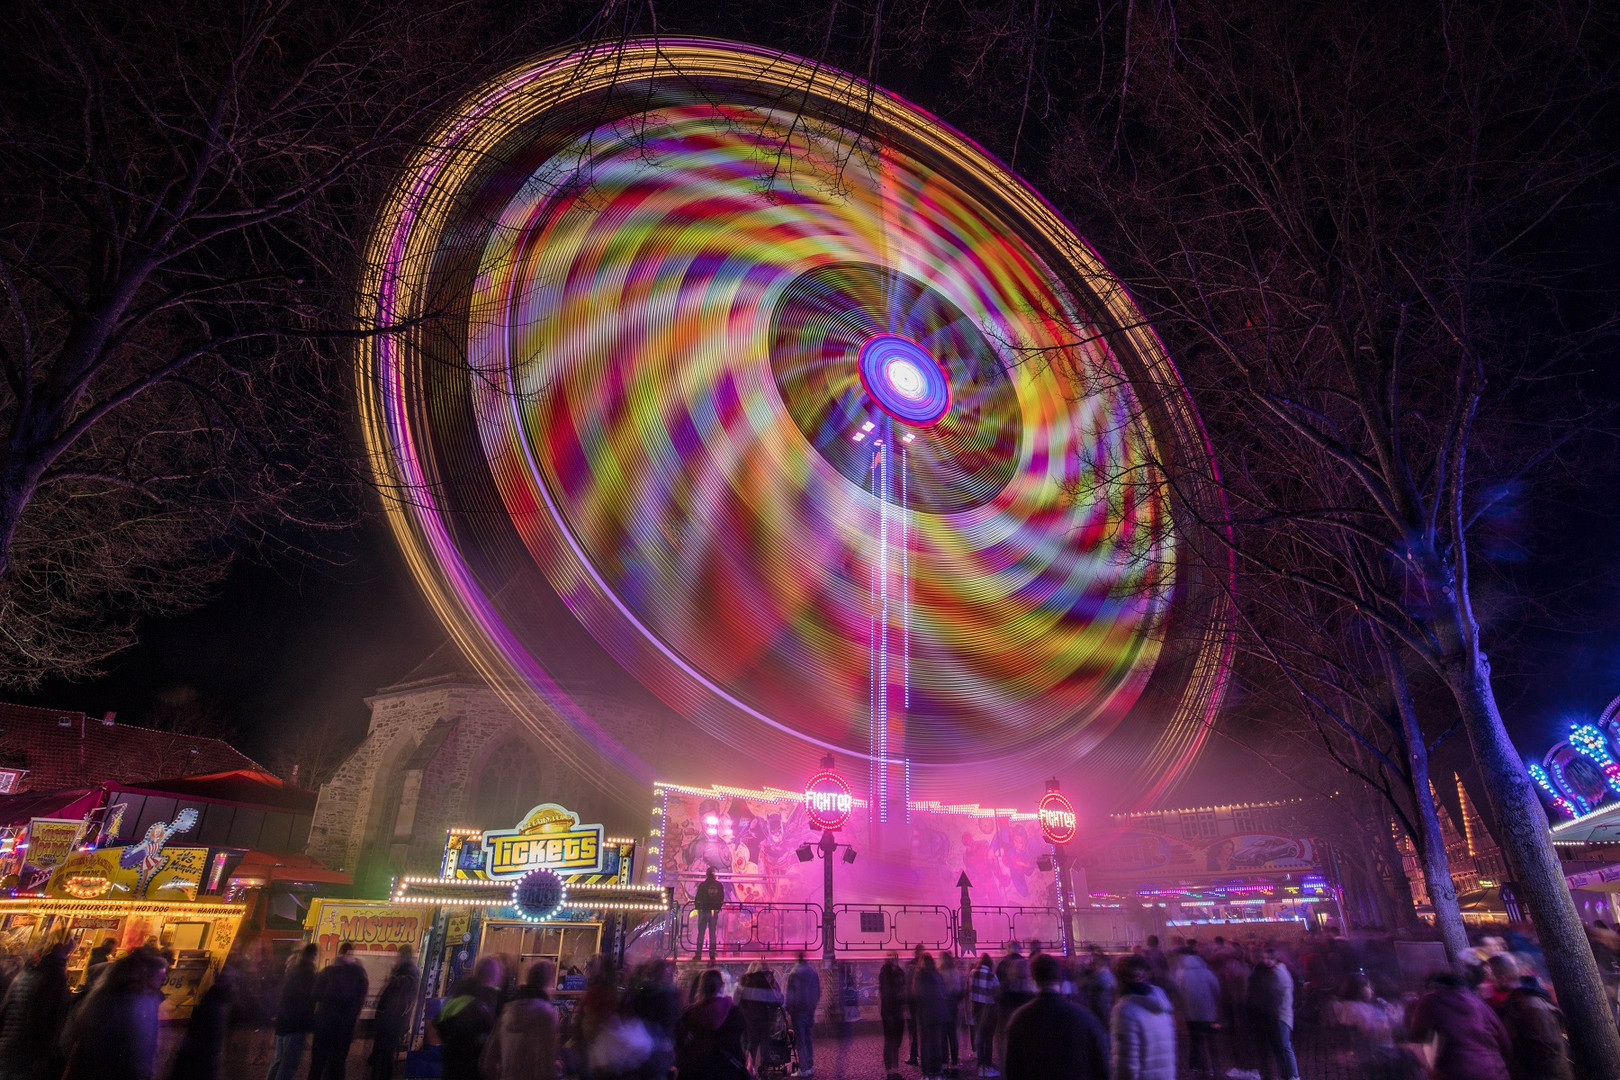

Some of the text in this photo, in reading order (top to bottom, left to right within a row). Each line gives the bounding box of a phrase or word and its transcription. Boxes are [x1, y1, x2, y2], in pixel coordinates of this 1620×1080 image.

[39, 903, 122, 912] HAWAIIBURGER
[135, 905, 152, 913] HOT
[153, 905, 170, 913] DOG
[339, 915, 418, 942] MISTER
